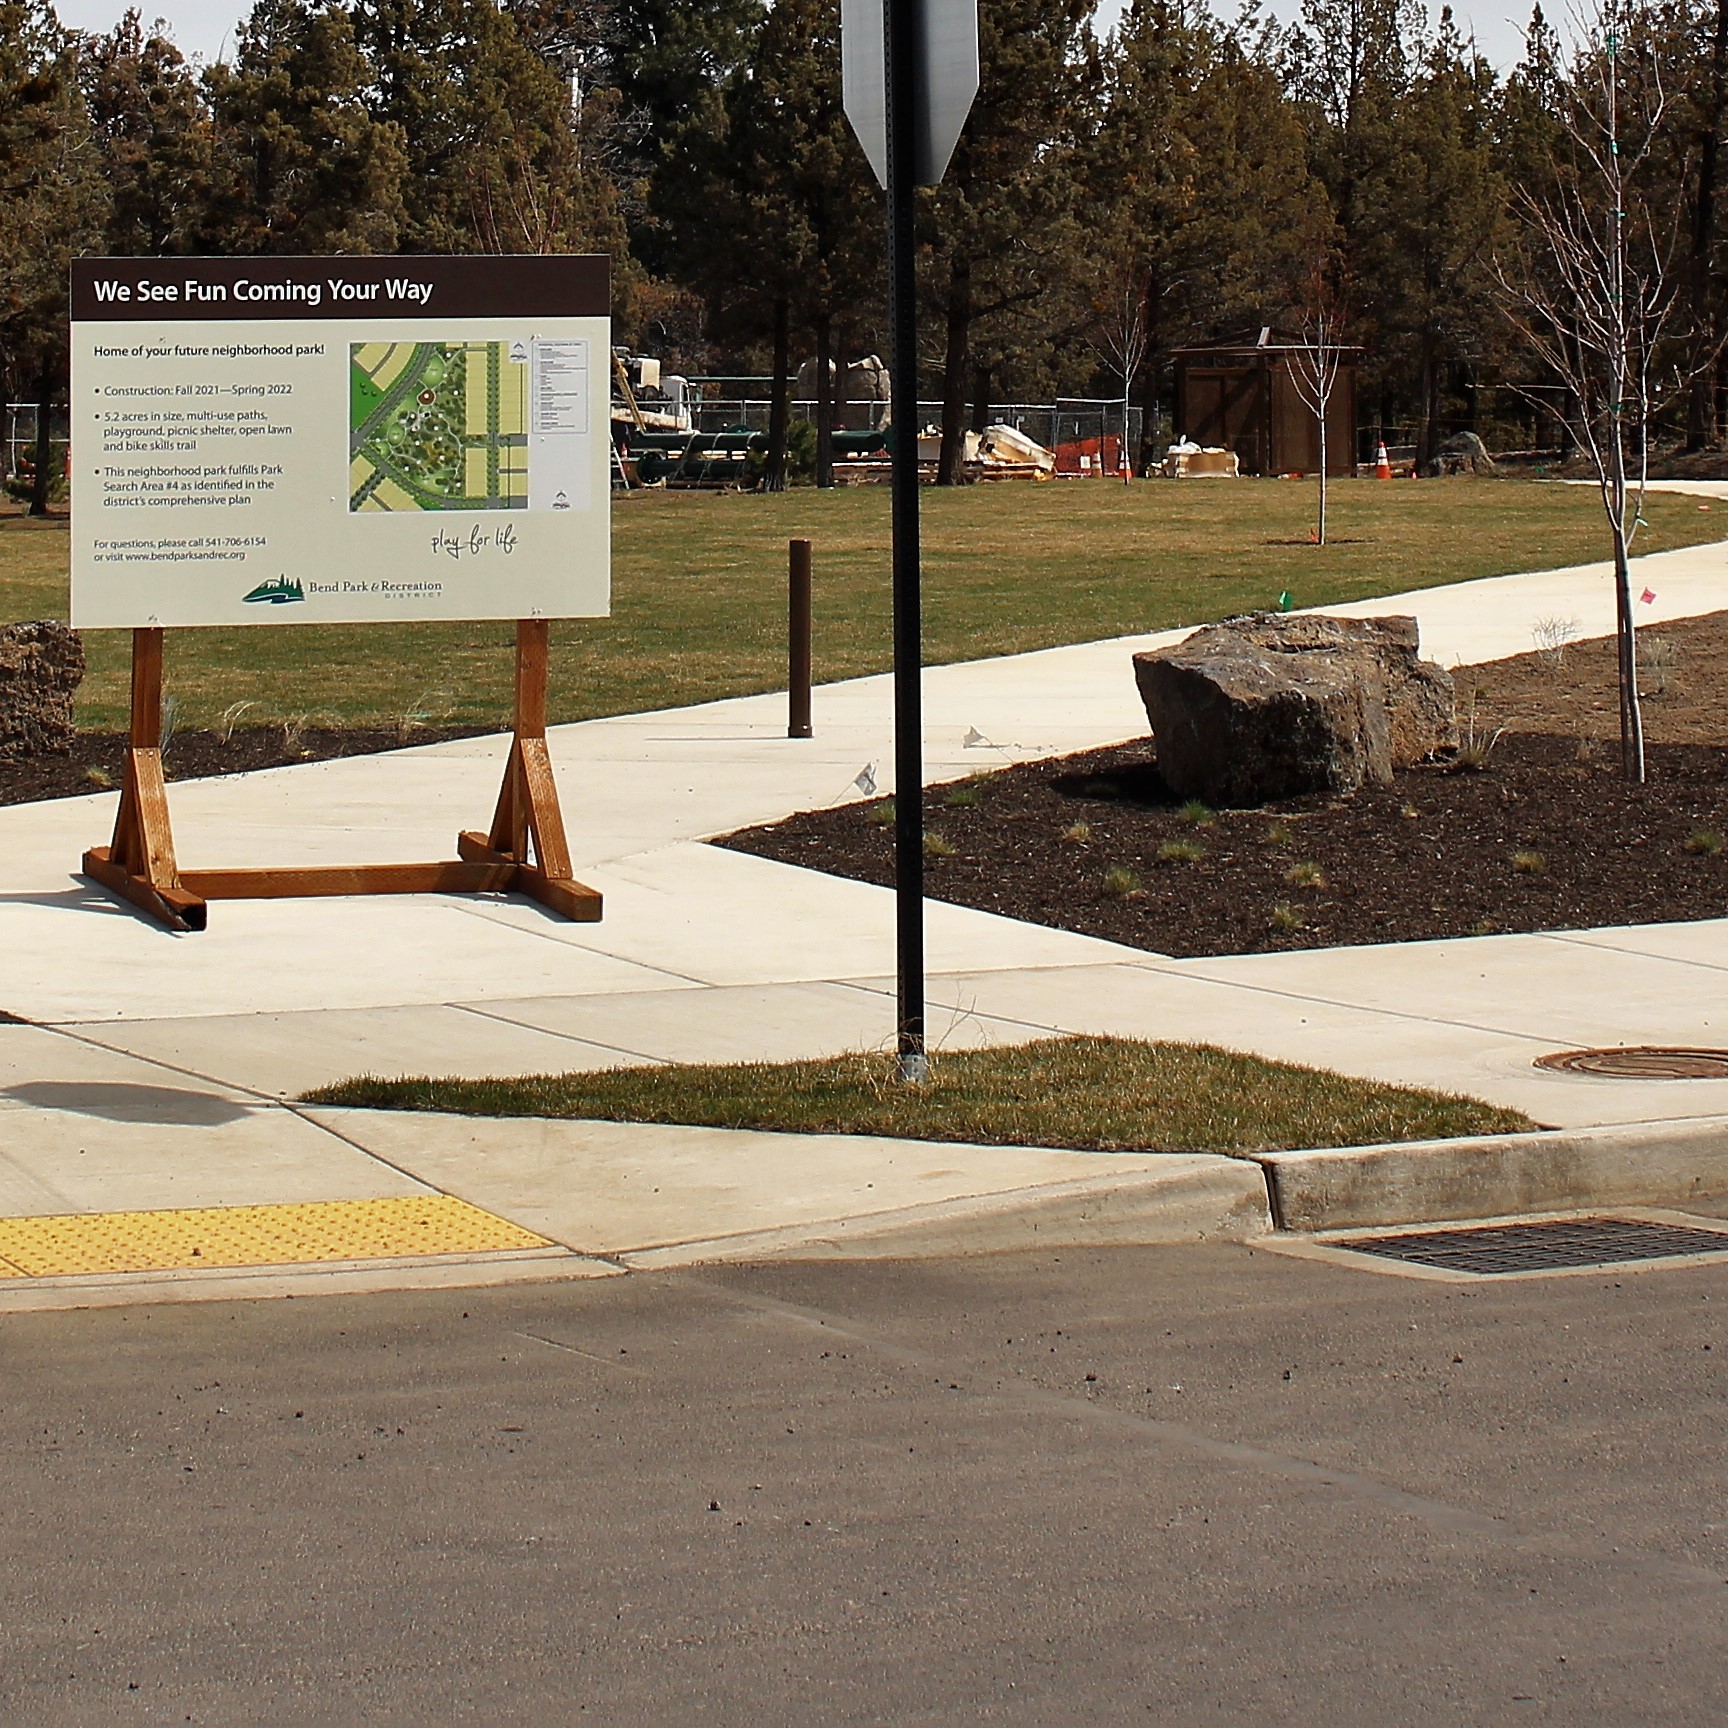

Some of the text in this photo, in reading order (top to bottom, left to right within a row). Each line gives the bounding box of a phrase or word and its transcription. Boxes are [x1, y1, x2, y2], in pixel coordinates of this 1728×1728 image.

[93, 278, 434, 306] We See Fun Coming Your Way
[94, 343, 325, 360] Home of your future neighborhood park!
[104, 385, 174, 397] Construction:
[176, 384, 193, 396] Fall
[268, 384, 293, 395] 2022
[104, 410, 268, 423] 5.2 acres in size, multi-use paths,
[167, 426, 198, 438] picnic
[200, 425, 237, 437] shelter,
[239, 426, 266, 437] open
[268, 423, 293, 435] lawn
[103, 439, 197, 452] and bike skills trail
[103, 464, 283, 479] This neighborhood park fulfills Park
[103, 478, 275, 492] Search Area #4 as identified in the
[148, 495, 227, 508] comprehensive
[228, 493, 251, 507] plan
[94, 536, 267, 551] For questions, please call 541-706-6154
[430, 523, 519, 560] play for life
[93, 550, 246, 563] or visit www.bendparksandrec.org
[309, 580, 442, 593] Bend Park & Recreation
